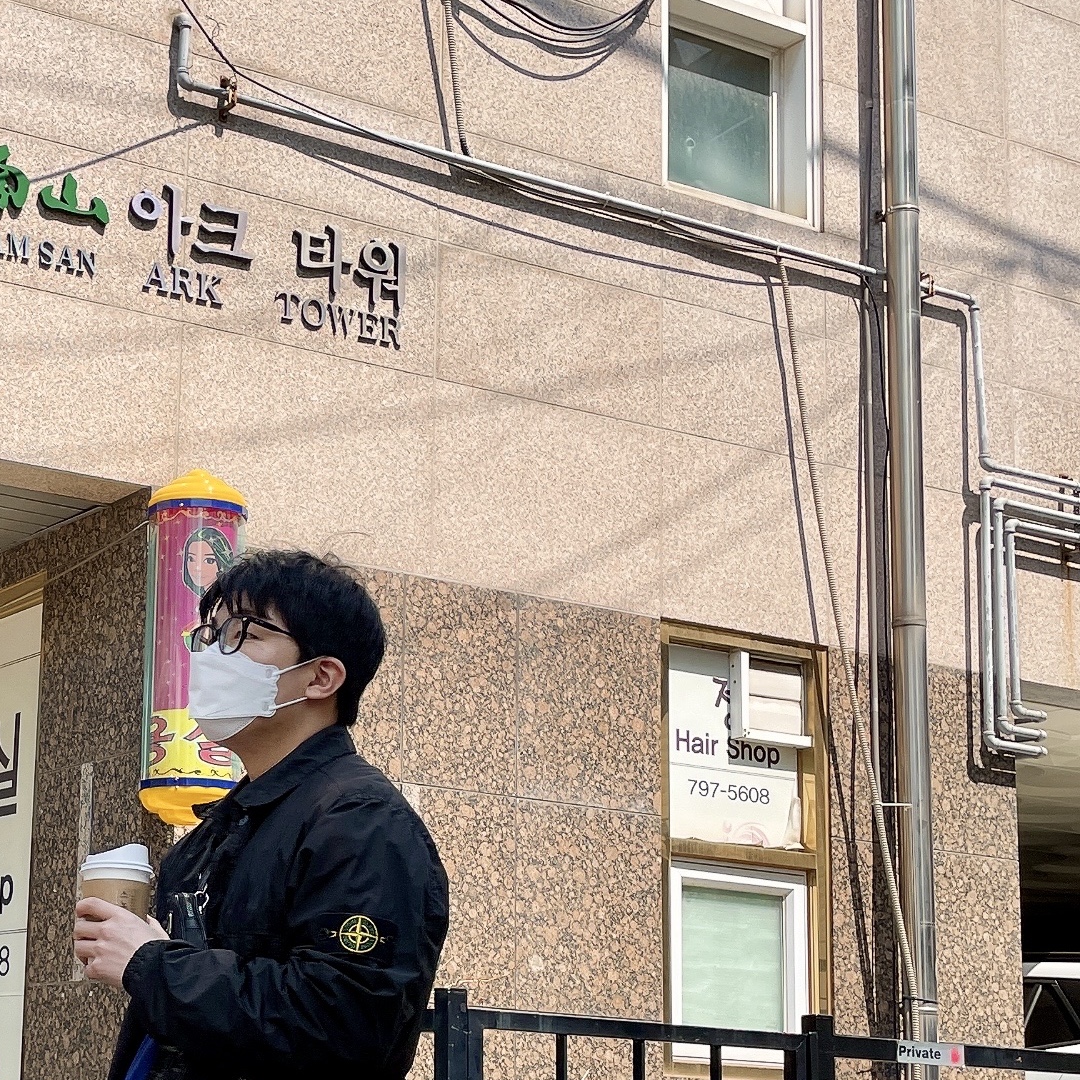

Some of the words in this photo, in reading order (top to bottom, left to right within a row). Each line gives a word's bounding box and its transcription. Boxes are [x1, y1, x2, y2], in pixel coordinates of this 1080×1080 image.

[128, 183, 254, 271] 아크
[292, 224, 407, 316] 타워
[142, 262, 224, 310] ARK
[274, 291, 401, 350] TOWER
[676, 729, 719, 756] Hair
[727, 736, 780, 768] Shop
[687, 778, 770, 804] 797-5608
[899, 1045, 942, 1060] Private
